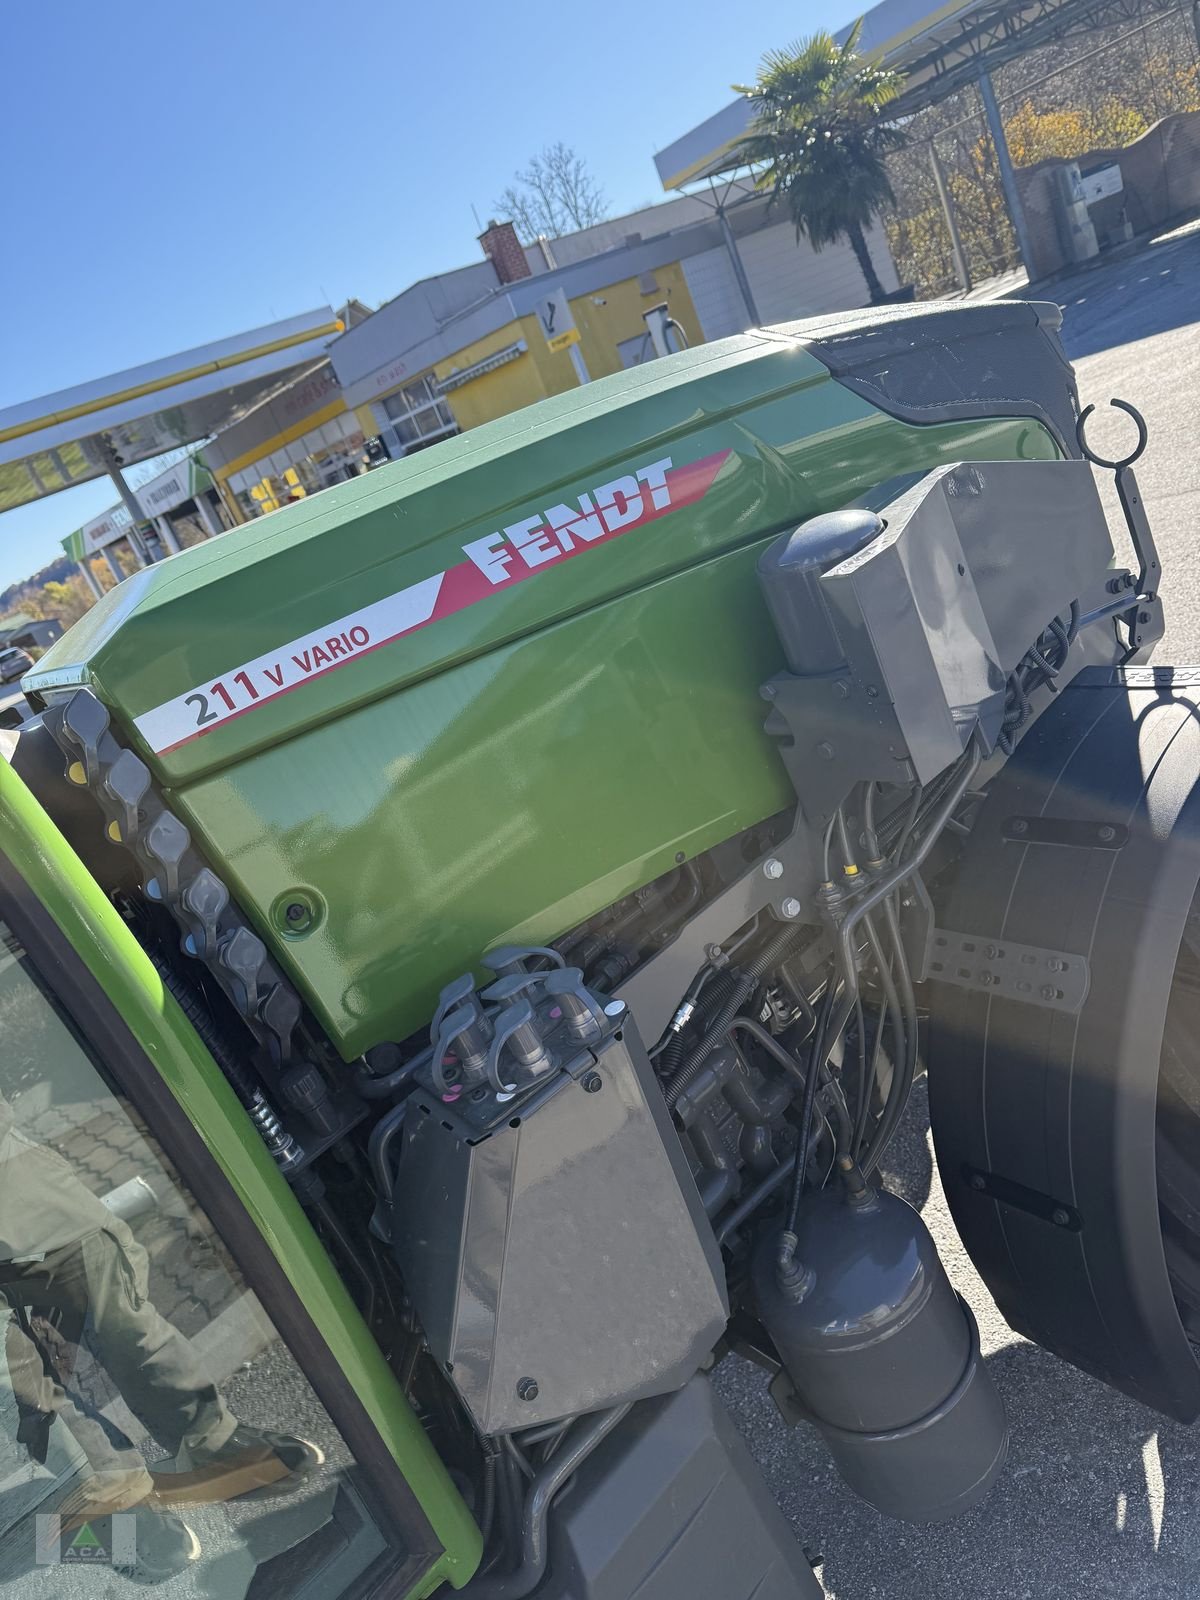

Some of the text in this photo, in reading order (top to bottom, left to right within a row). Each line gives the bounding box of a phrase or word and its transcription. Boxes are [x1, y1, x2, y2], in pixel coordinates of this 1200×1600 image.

[461, 456, 673, 585] FENDT
[184, 625, 370, 726] 211 V VARIO
